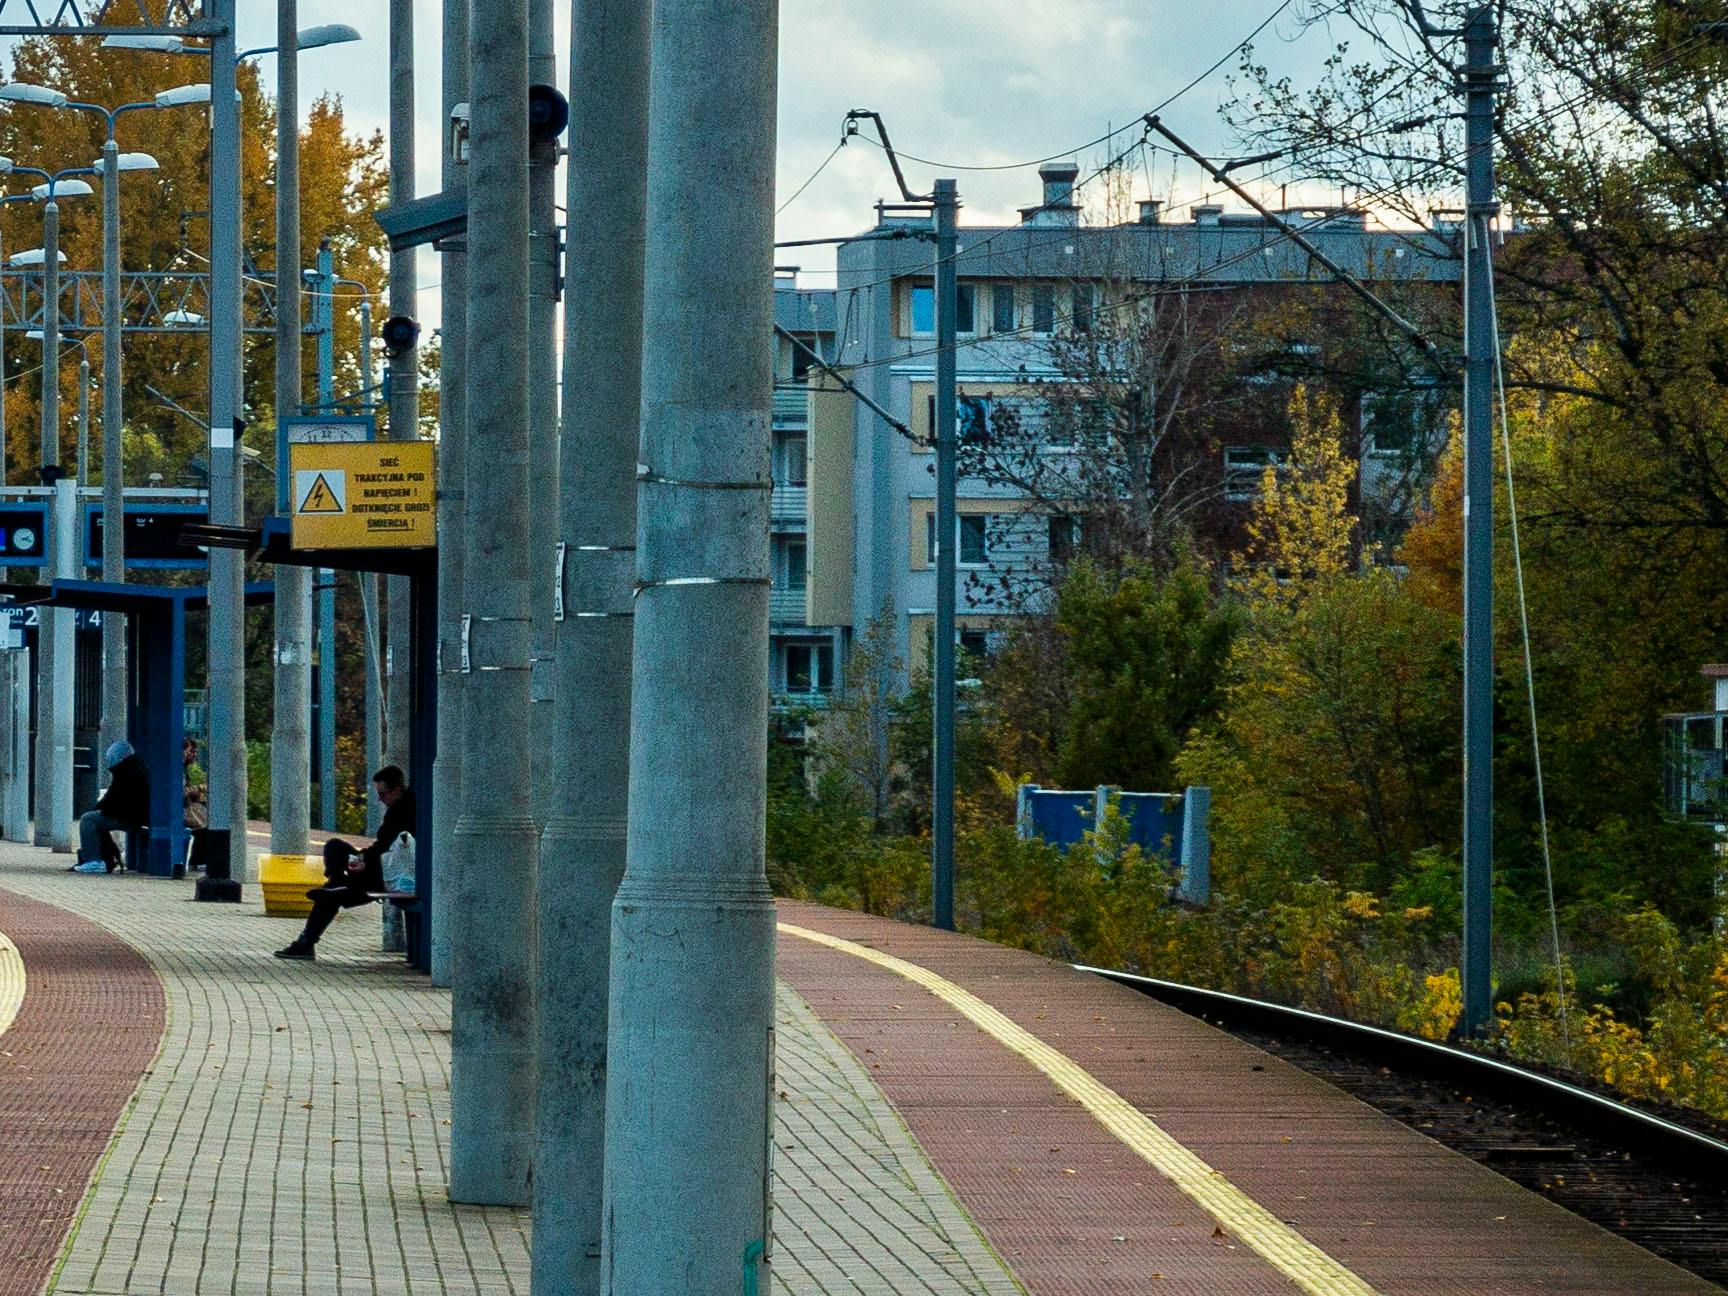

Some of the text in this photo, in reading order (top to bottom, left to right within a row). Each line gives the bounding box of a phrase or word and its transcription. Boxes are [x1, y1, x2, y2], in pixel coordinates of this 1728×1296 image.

[354, 472, 424, 483] TRAKCYJNA POD
[25, 607, 38, 625] 2
[89, 610, 101, 626] 4
